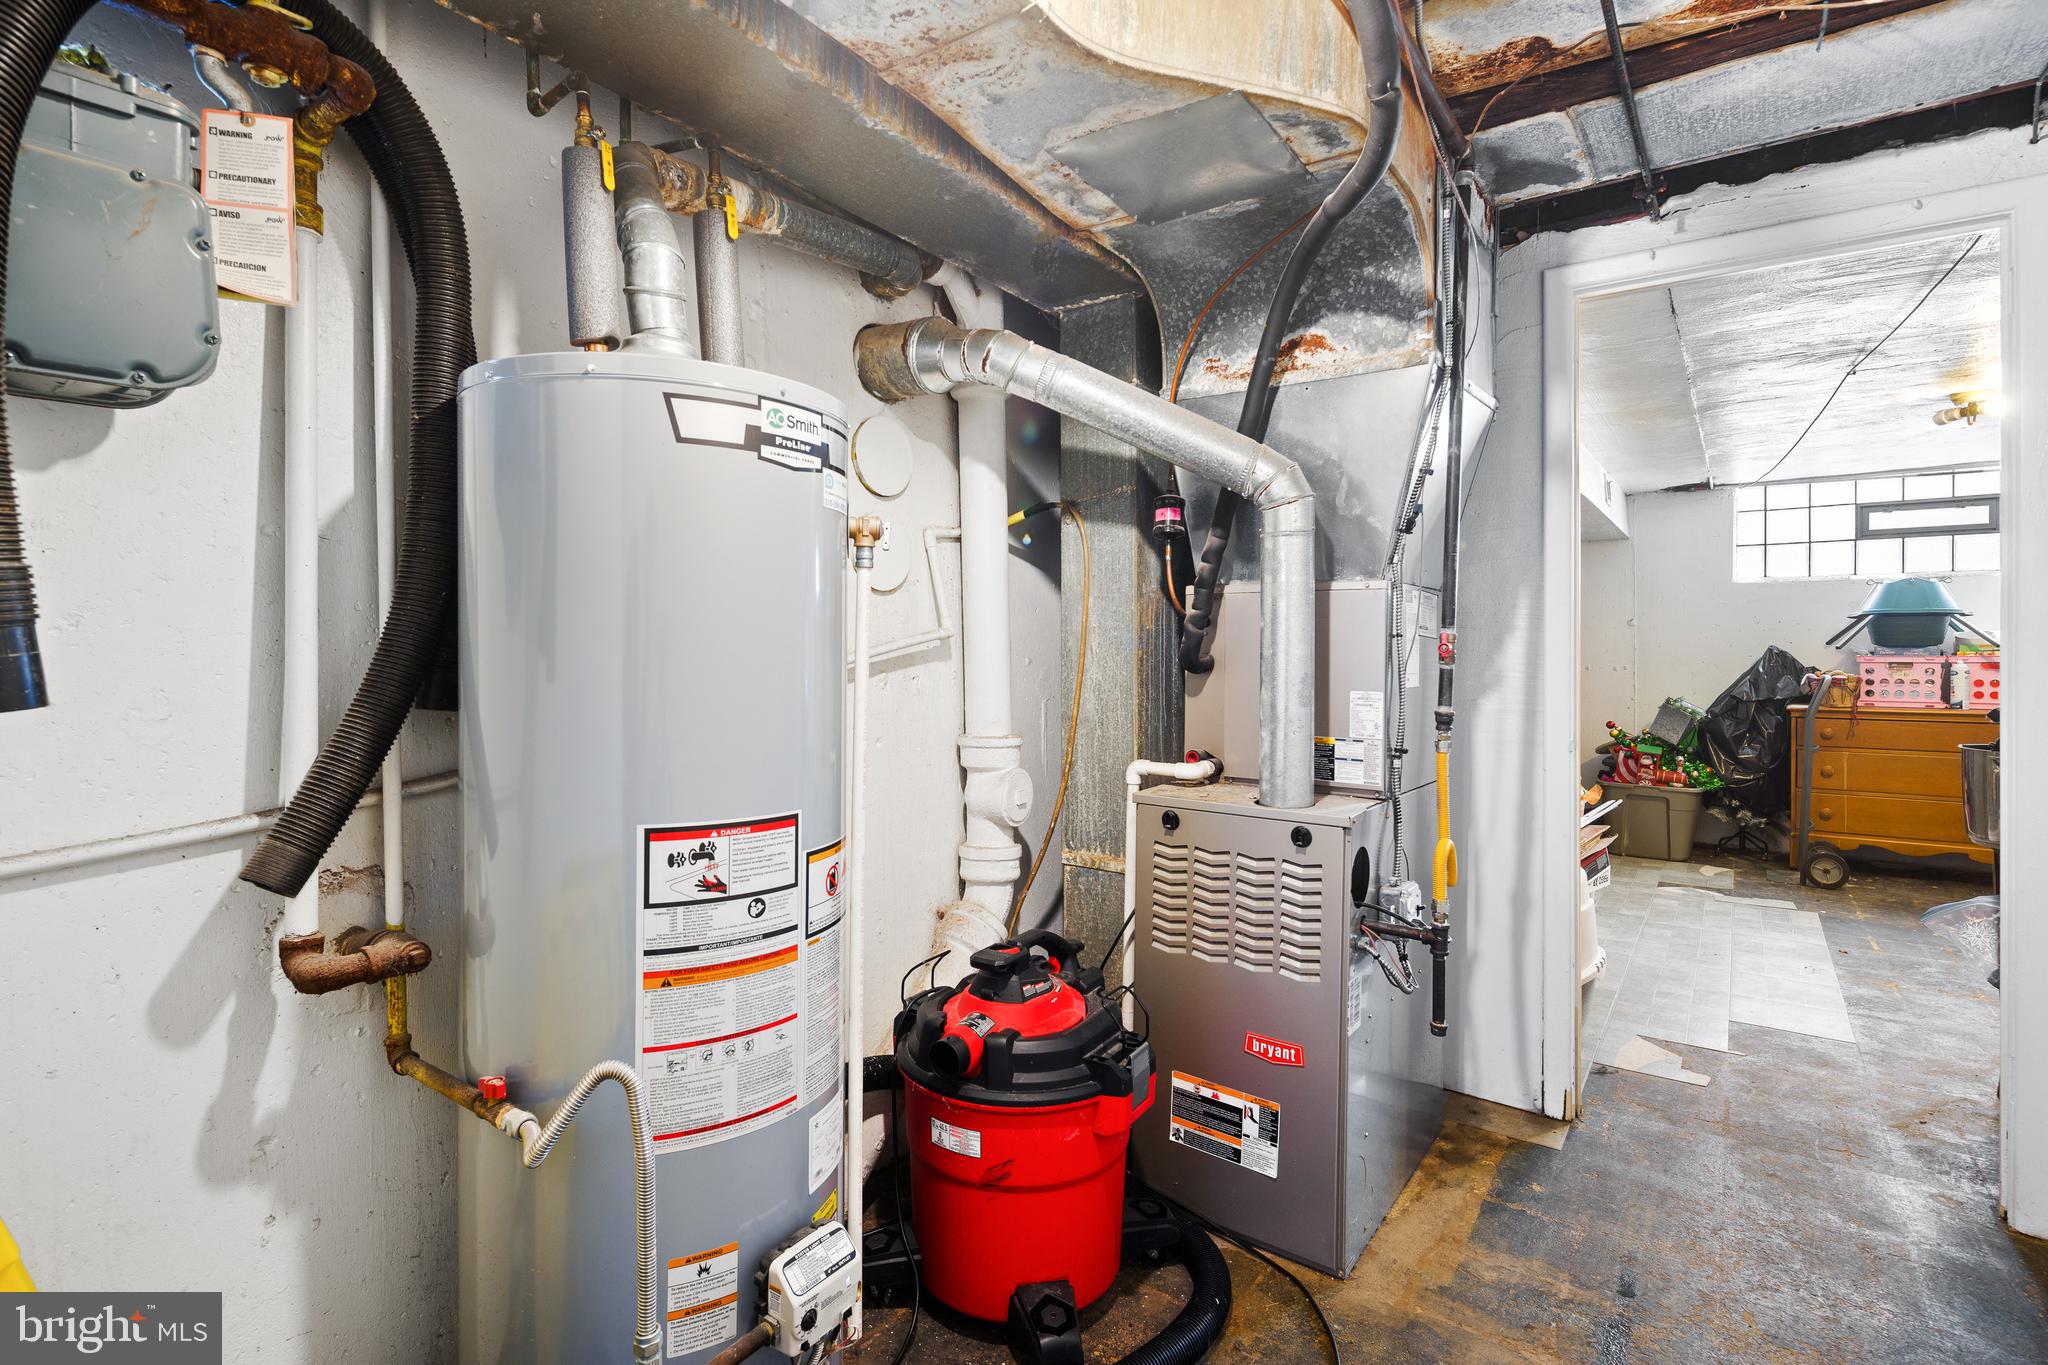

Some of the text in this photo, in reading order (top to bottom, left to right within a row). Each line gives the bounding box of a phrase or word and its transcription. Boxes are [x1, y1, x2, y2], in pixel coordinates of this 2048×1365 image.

[218, 128, 253, 139] WARNING
[218, 172, 277, 185] PRECAUTIONARY
[218, 209, 241, 219] AVISO
[219, 259, 267, 272] PRECAUCION
[786, 415, 819, 436] Smith
[775, 436, 812, 452] ProLine
[720, 827, 751, 836] DANGER
[1252, 1038, 1296, 1062] bryant
[692, 1249, 723, 1262] WARNING
[691, 1300, 722, 1313] WARNING
